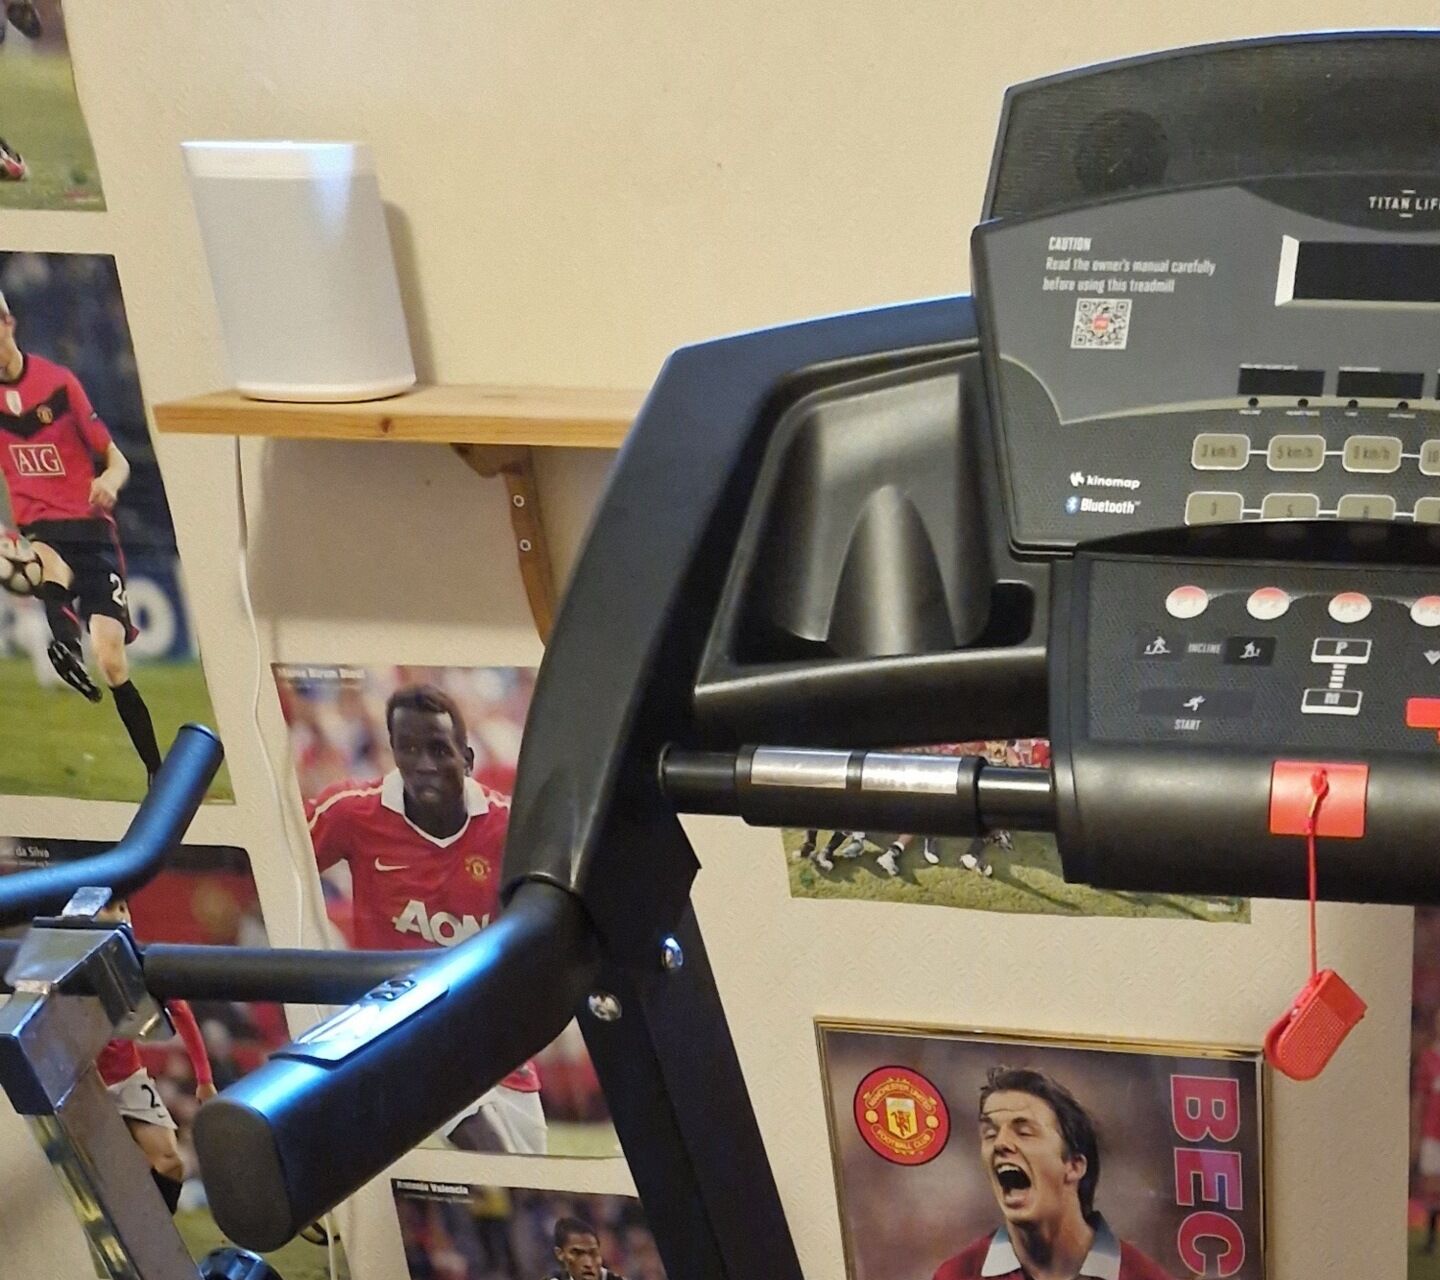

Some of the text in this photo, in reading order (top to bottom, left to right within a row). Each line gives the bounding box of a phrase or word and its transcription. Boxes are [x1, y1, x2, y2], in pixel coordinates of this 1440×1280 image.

[1368, 196, 1410, 209] TITAN
[1048, 237, 1093, 251] CAUTION
[1045, 257, 1216, 276] Read the owner's manual carefully
[1042, 277, 1176, 293] before using this treadmill
[18, 448, 61, 473] AIG
[1086, 474, 1141, 490] kinomap
[1187, 642, 1221, 655] INCLINE
[1335, 641, 1348, 655] P
[1323, 692, 1340, 705] M
[1174, 718, 1201, 731] START
